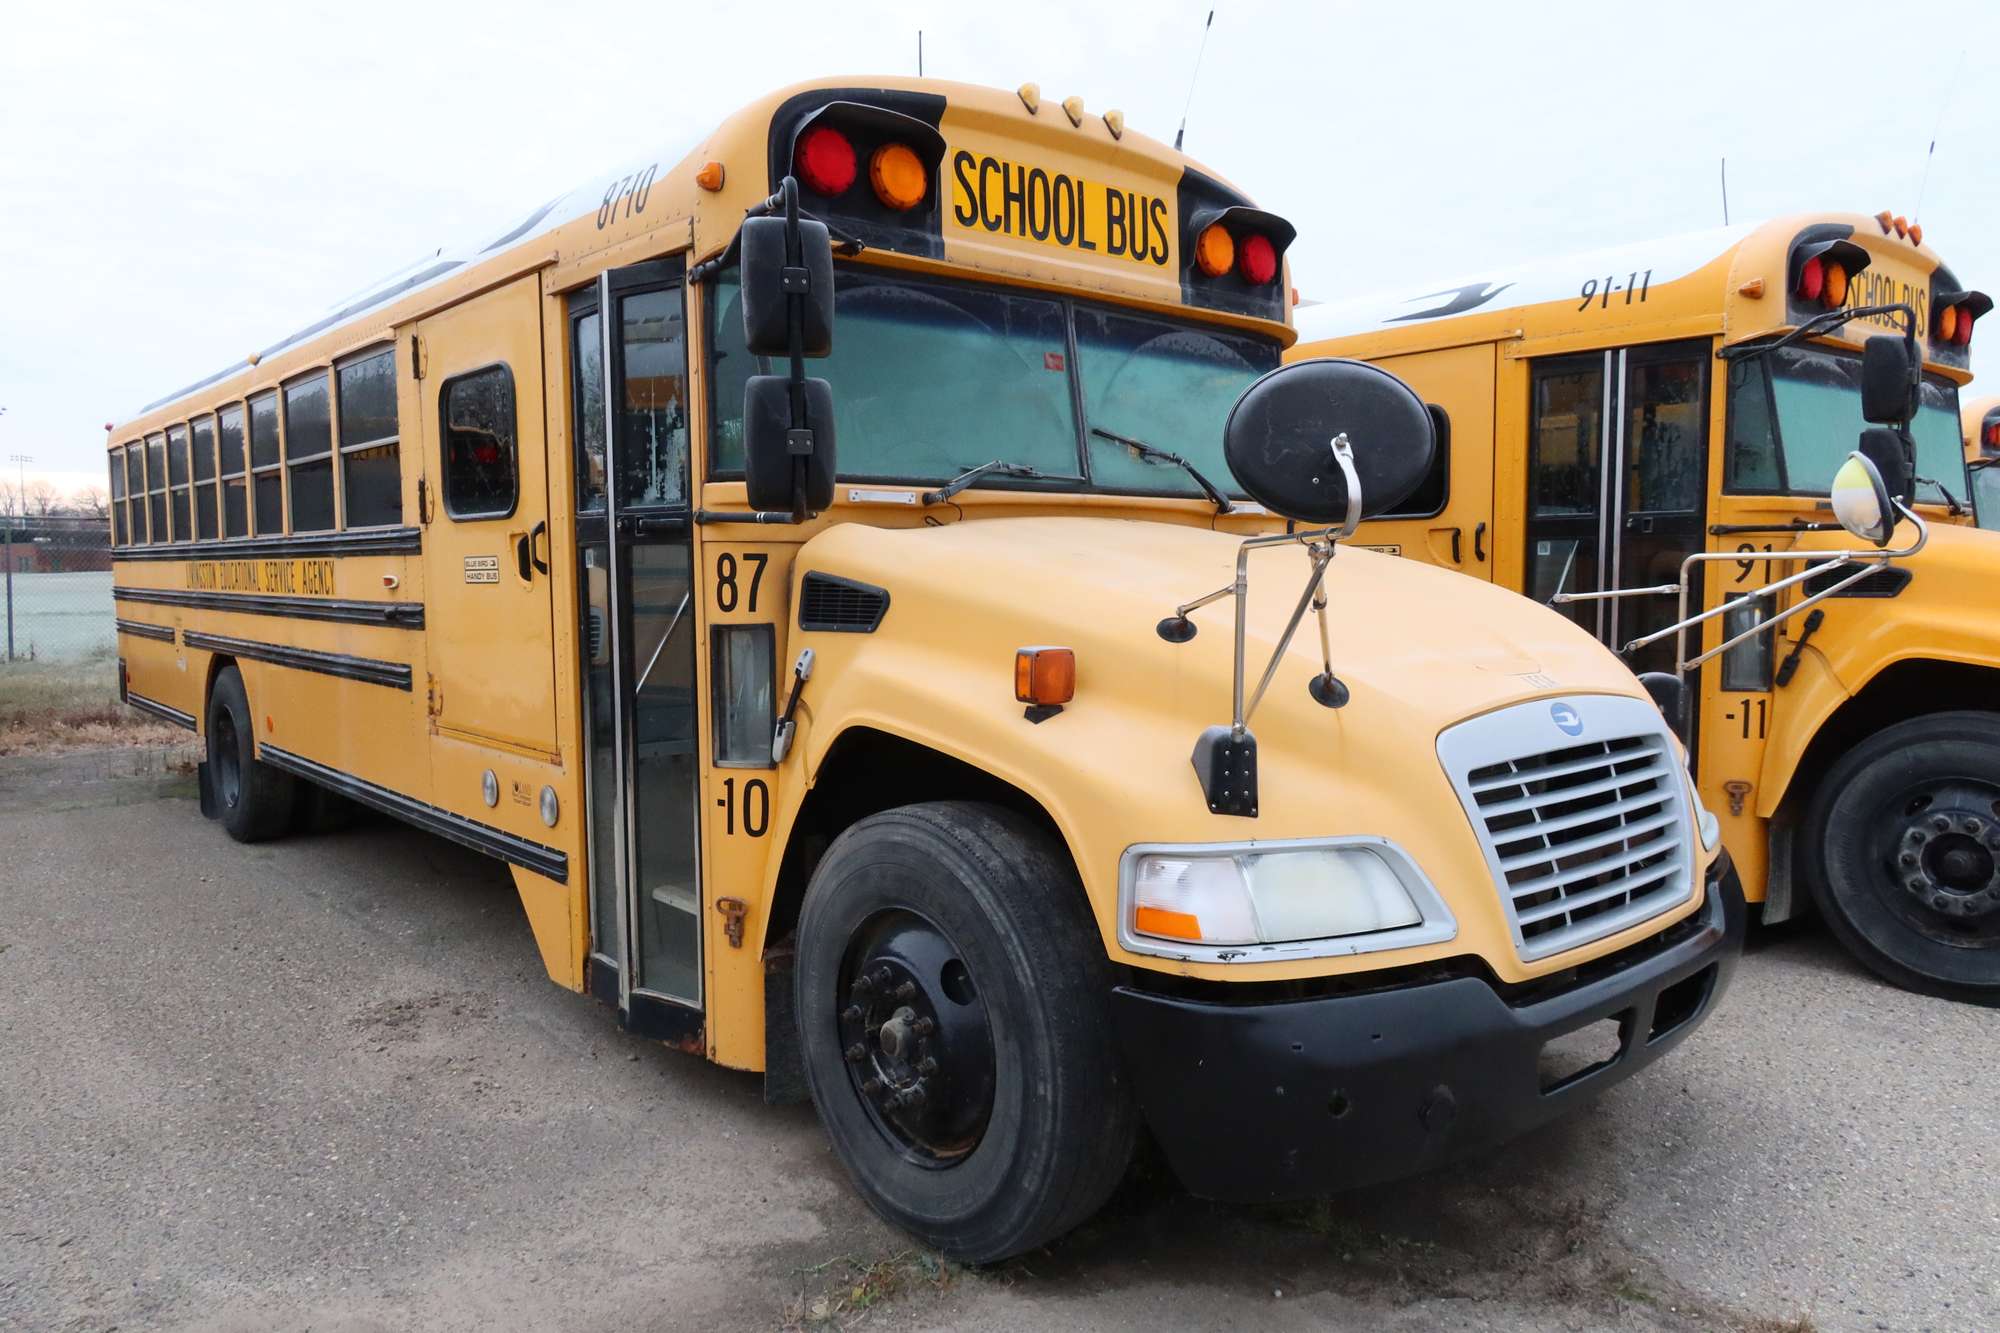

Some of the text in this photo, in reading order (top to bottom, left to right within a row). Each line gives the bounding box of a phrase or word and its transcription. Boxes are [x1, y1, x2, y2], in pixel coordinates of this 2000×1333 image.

[596, 163, 658, 231] 87-10
[953, 150, 1169, 266] SCHOOL BUS
[1578, 268, 1652, 313] 91-11
[265, 560, 296, 593] SERVICE
[302, 559, 335, 595] AGENCY
[716, 552, 769, 613] 87
[1734, 543, 1773, 585] 91
[1725, 698, 1767, 740] -11
[716, 777, 770, 838] -10
